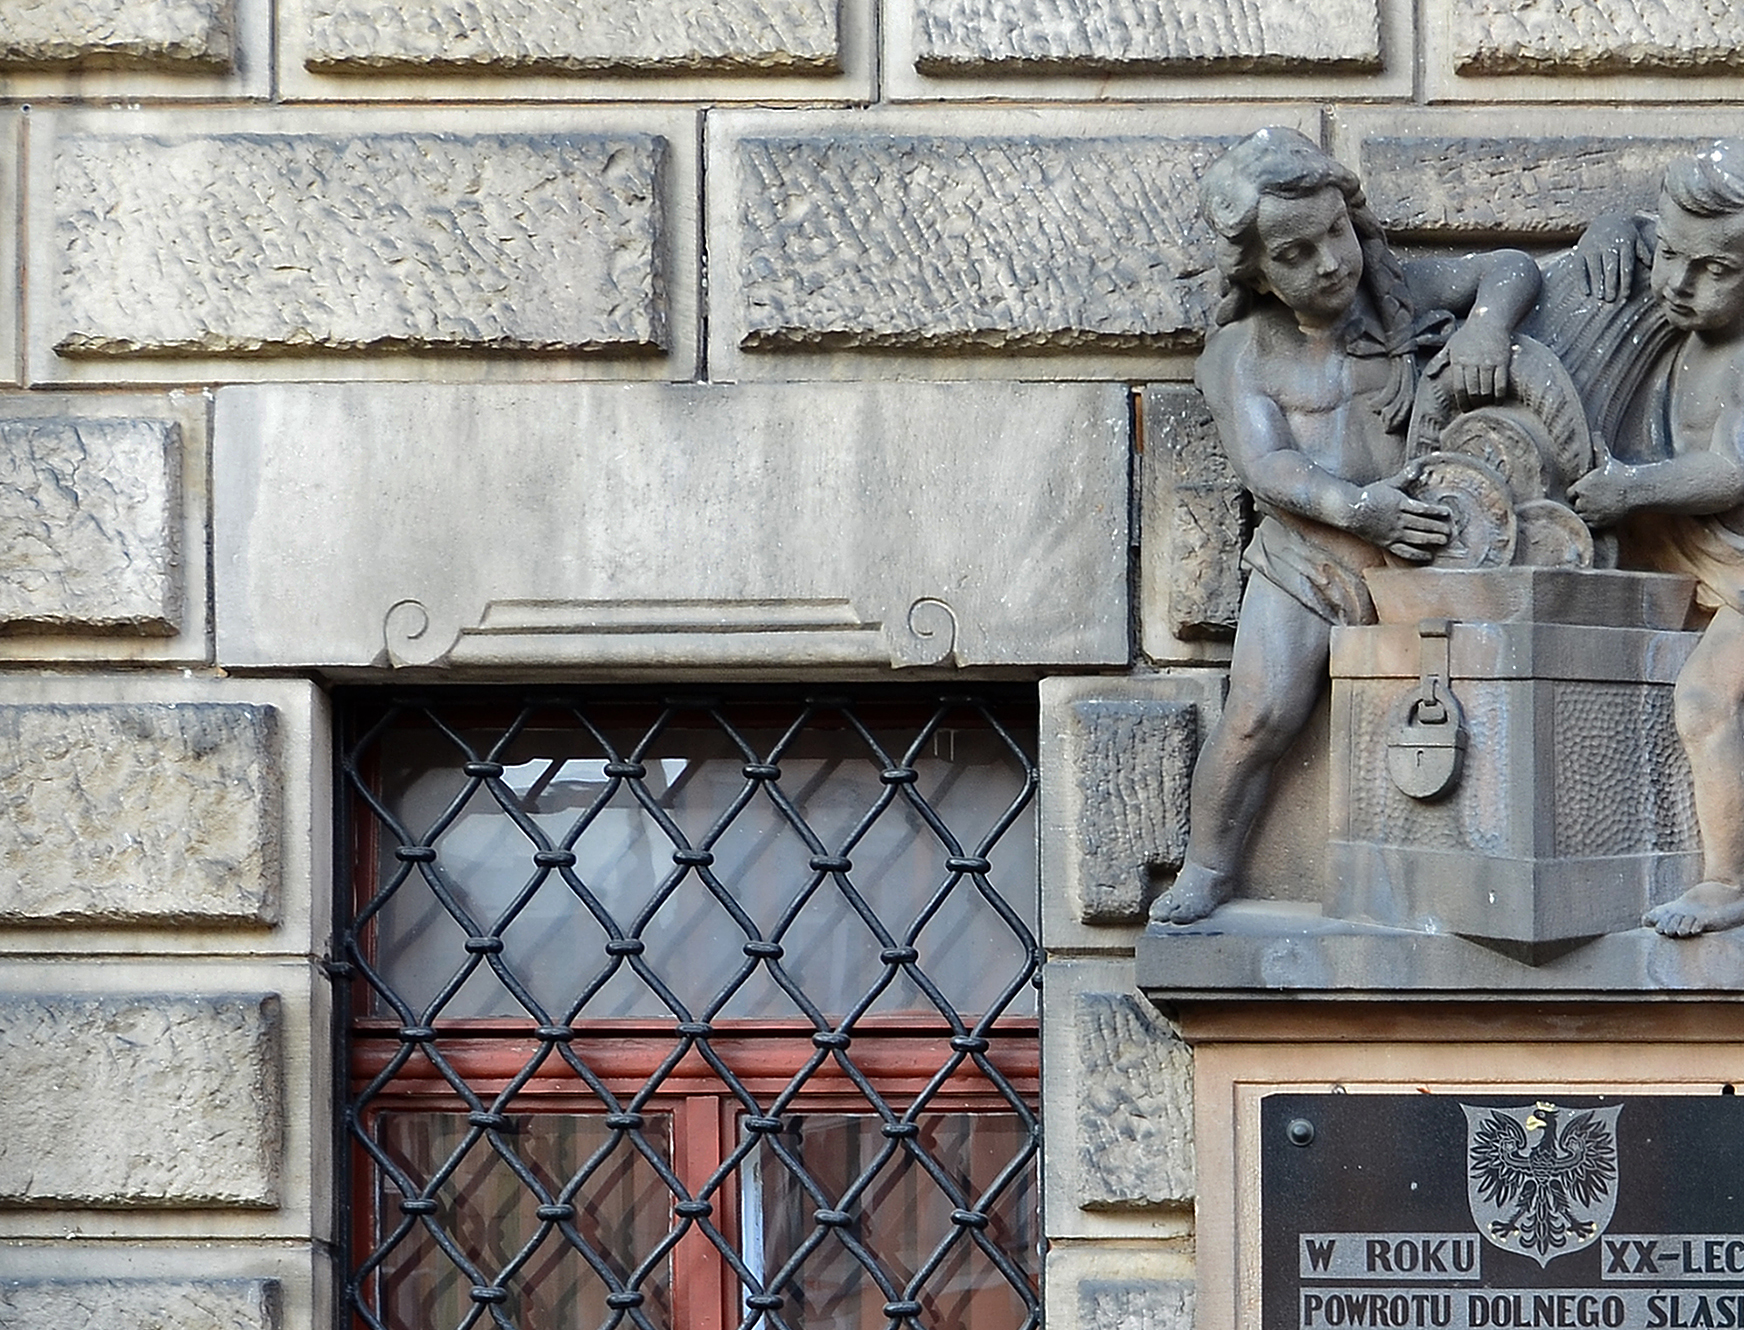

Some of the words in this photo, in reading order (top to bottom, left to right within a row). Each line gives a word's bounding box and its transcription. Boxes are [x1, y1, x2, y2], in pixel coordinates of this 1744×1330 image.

[1305, 1239, 1334, 1272] W
[1366, 1239, 1474, 1272] ROKU
[1303, 1295, 1452, 1328] POWROTU
[1468, 1295, 1624, 1328] DOLNEGO
